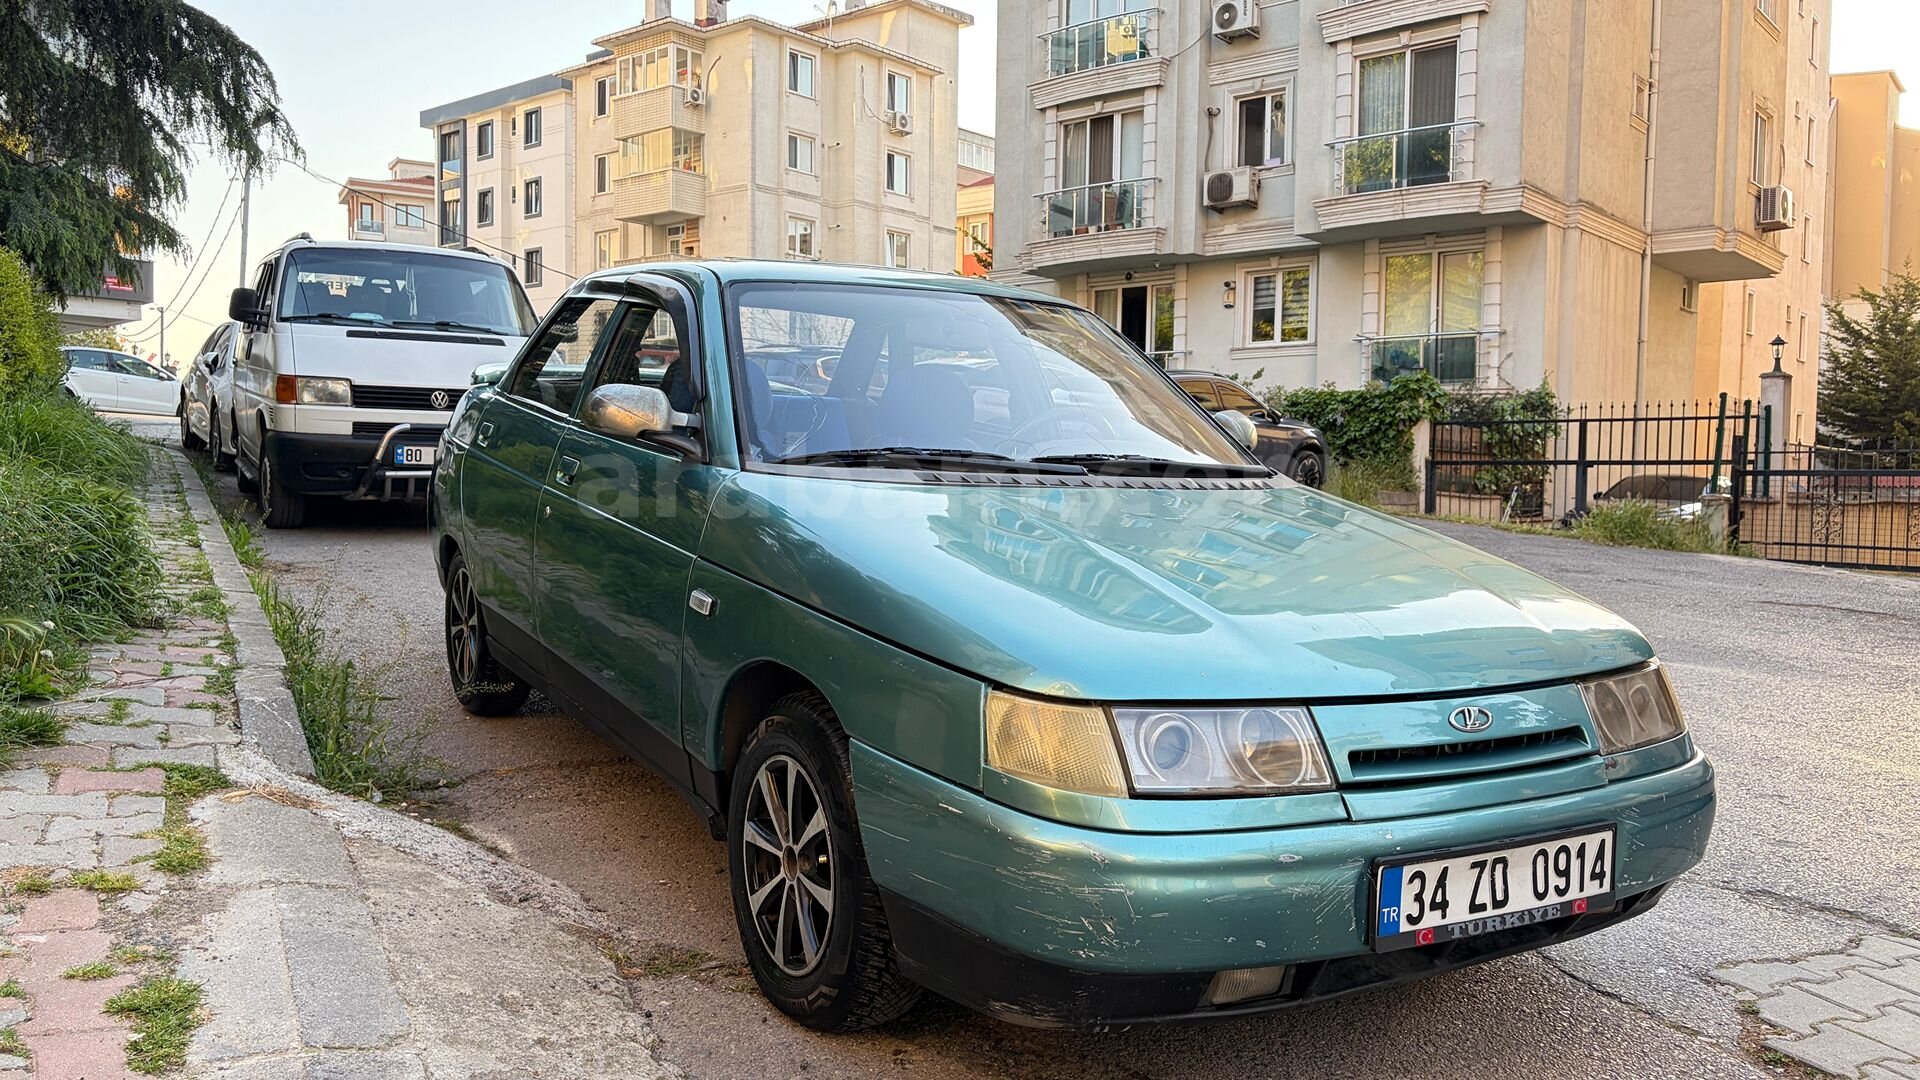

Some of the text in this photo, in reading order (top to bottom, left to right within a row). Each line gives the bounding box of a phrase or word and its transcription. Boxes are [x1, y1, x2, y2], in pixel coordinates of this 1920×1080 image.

[406, 449, 422, 462] 80
[1382, 838, 1606, 926] TR 34 ZD 0914
